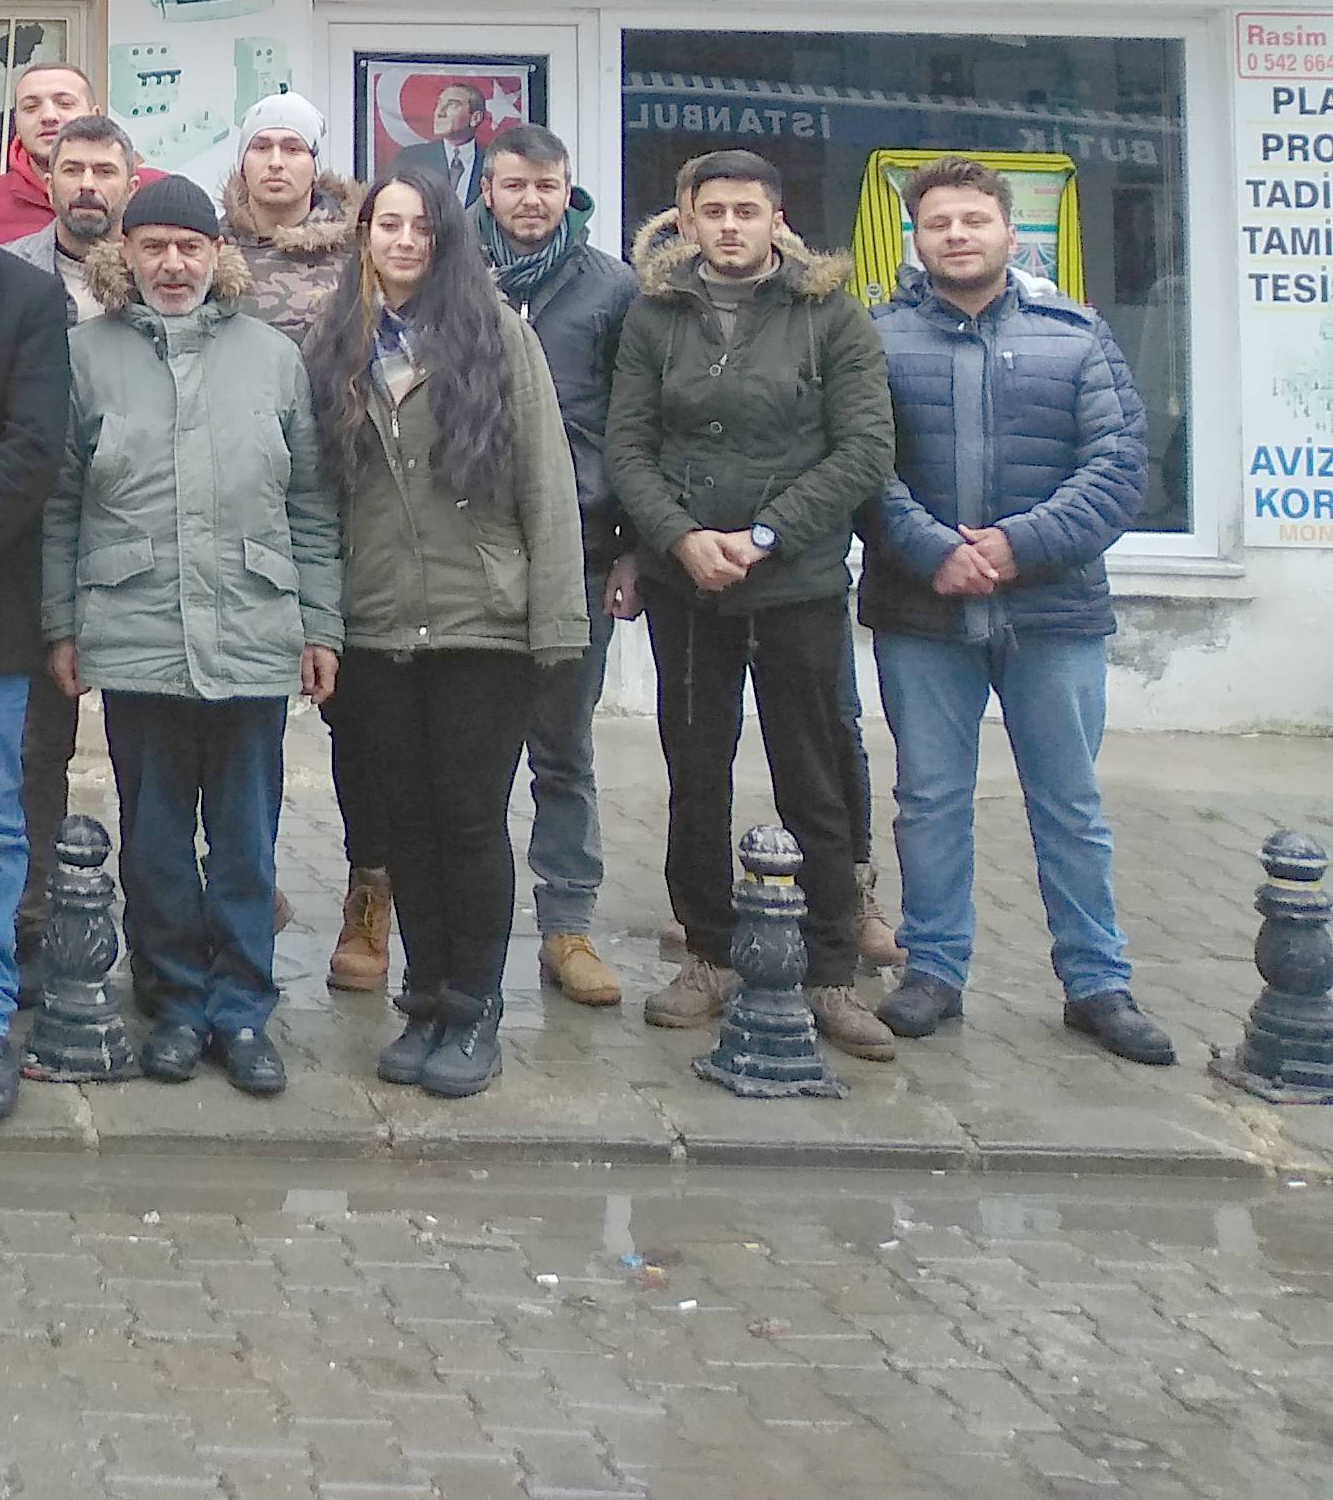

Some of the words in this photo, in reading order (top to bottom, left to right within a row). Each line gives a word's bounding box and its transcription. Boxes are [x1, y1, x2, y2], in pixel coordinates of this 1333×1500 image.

[1247, 24, 1327, 46] Rasim
[1247, 53, 1258, 71] 0
[1264, 53, 1297, 71] 542
[1245, 172, 1331, 209] TADİ
[1242, 218, 1333, 256] TAMİ
[1248, 265, 1333, 303] TESİ
